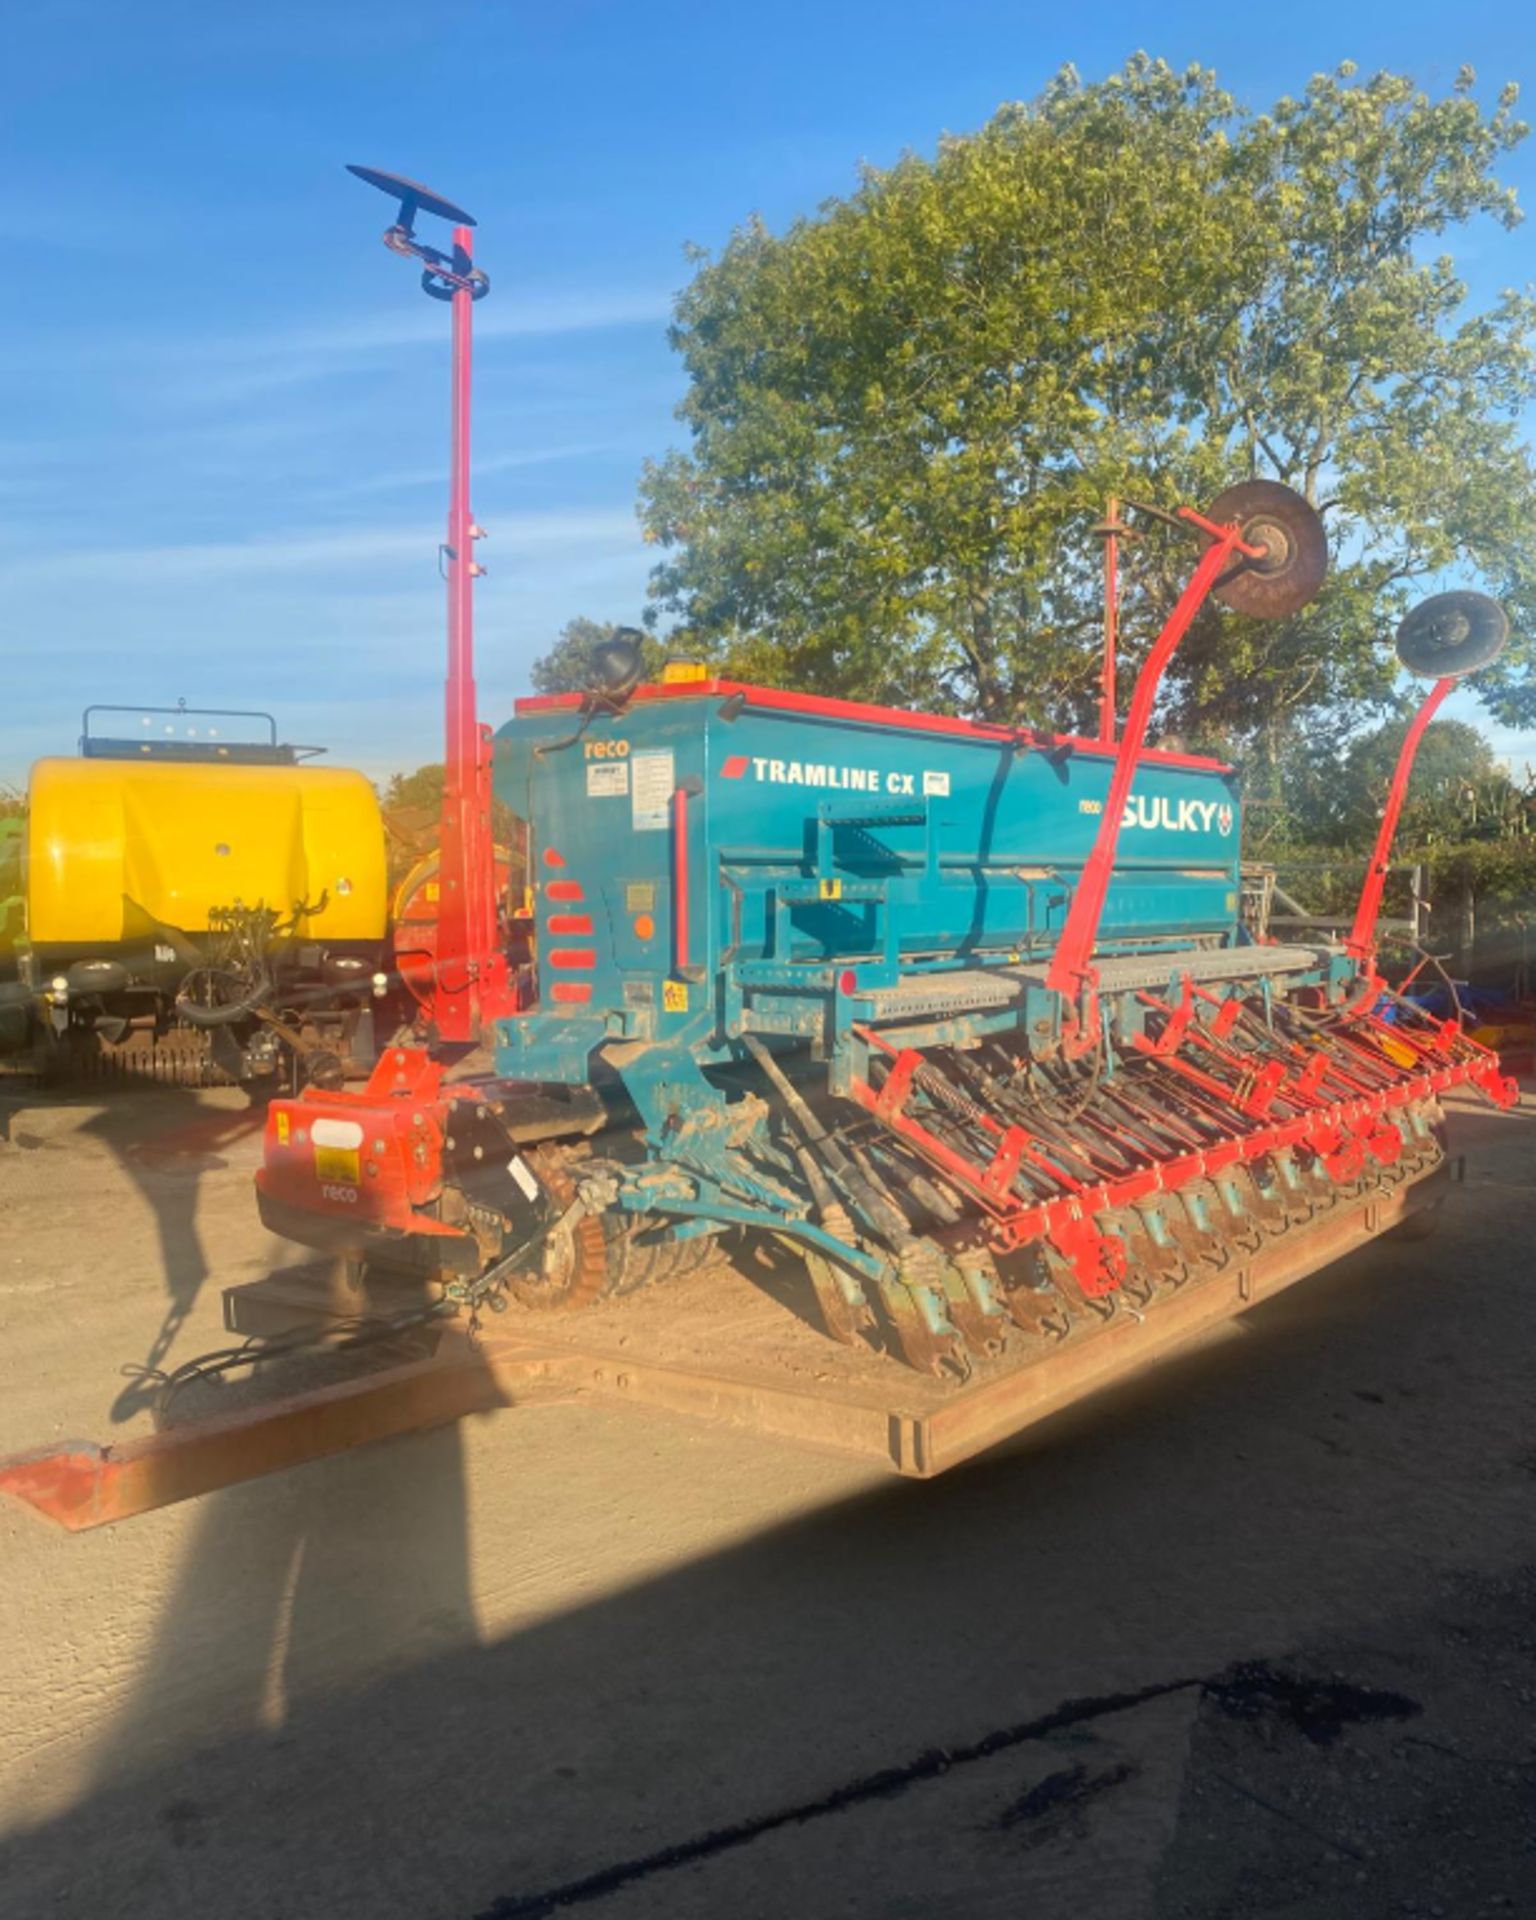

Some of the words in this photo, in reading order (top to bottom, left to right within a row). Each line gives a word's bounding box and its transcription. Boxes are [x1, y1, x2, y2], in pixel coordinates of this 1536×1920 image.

[584, 739, 630, 759] reco
[752, 757, 880, 792] TRAMLINE
[886, 772, 915, 795] CX
[1119, 794, 1218, 832] SULKY
[322, 1184, 358, 1203] reco
